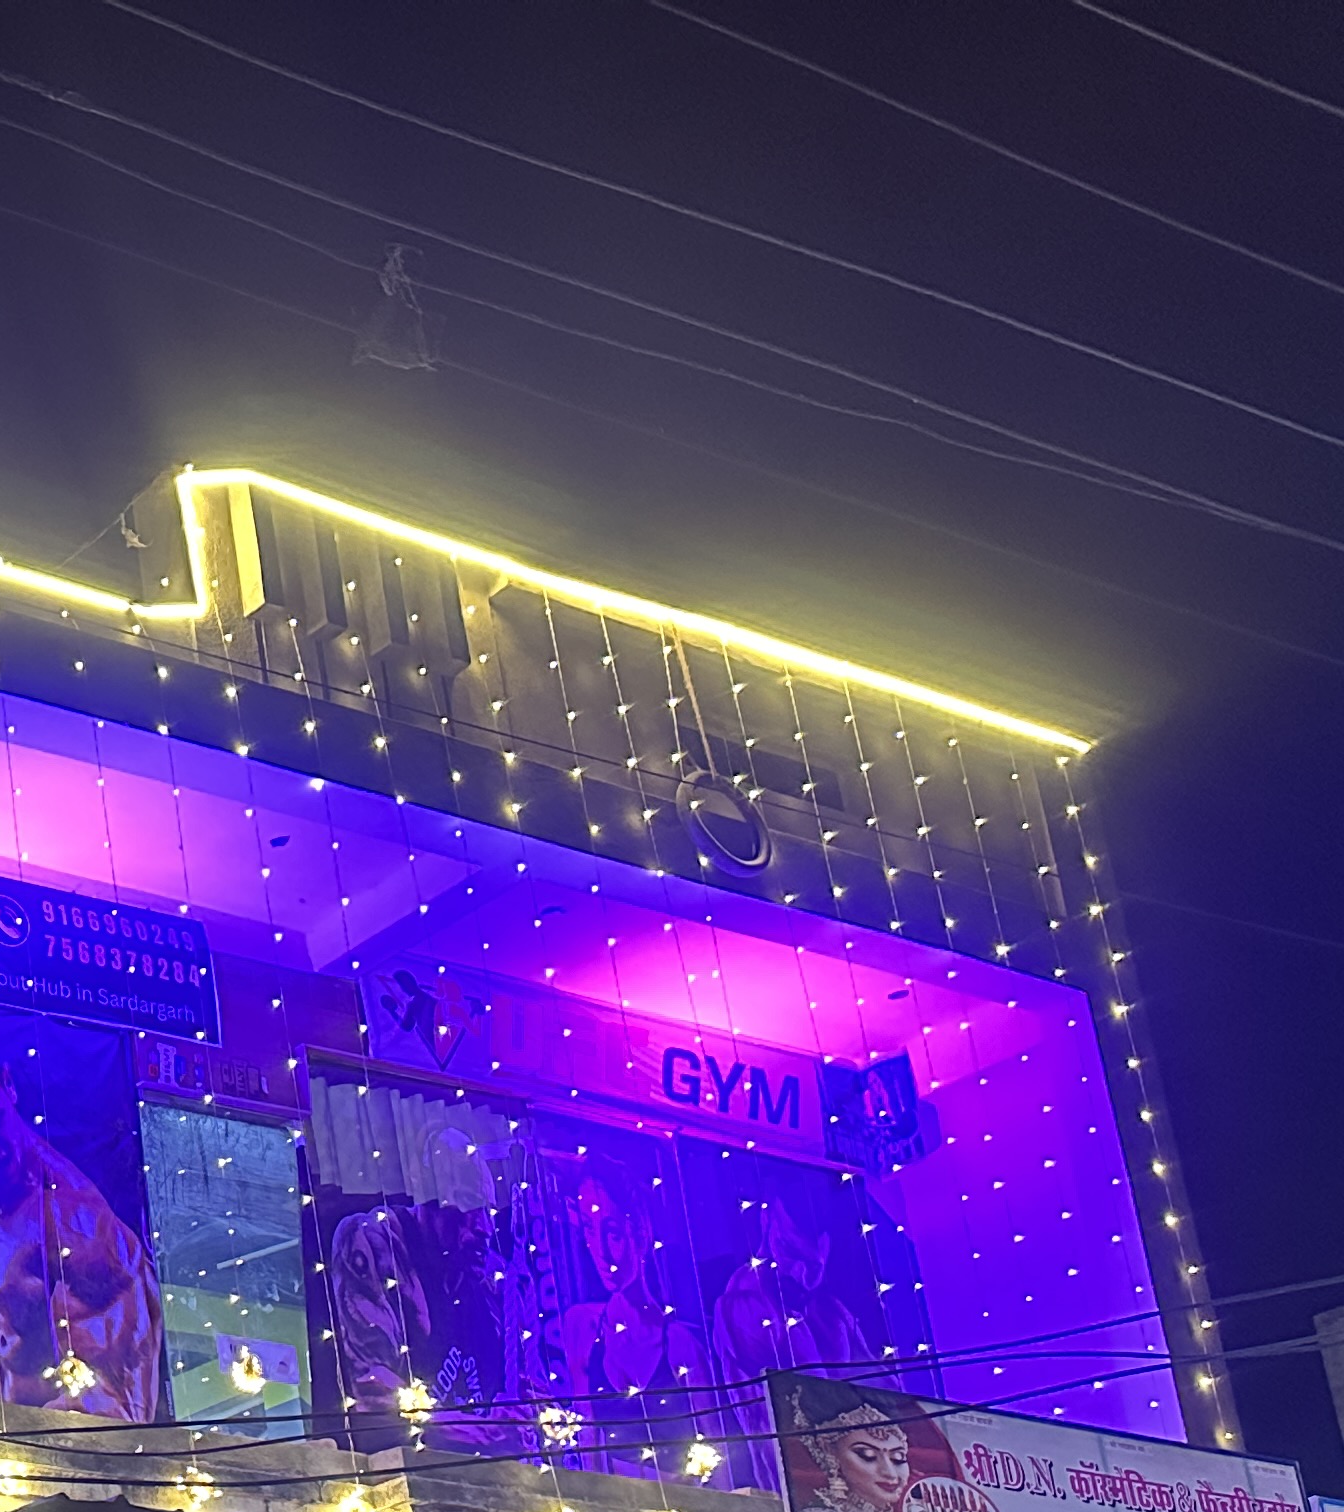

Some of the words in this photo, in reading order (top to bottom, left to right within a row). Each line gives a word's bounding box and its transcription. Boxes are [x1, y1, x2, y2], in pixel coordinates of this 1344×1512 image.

[33, 976, 71, 998] Hub
[76, 983, 93, 1002] in
[98, 989, 196, 1024] Sardargarh
[662, 1046, 800, 1129] GYM
[962, 1443, 999, 1489] श्री
[996, 1450, 1066, 1500] D.N.
